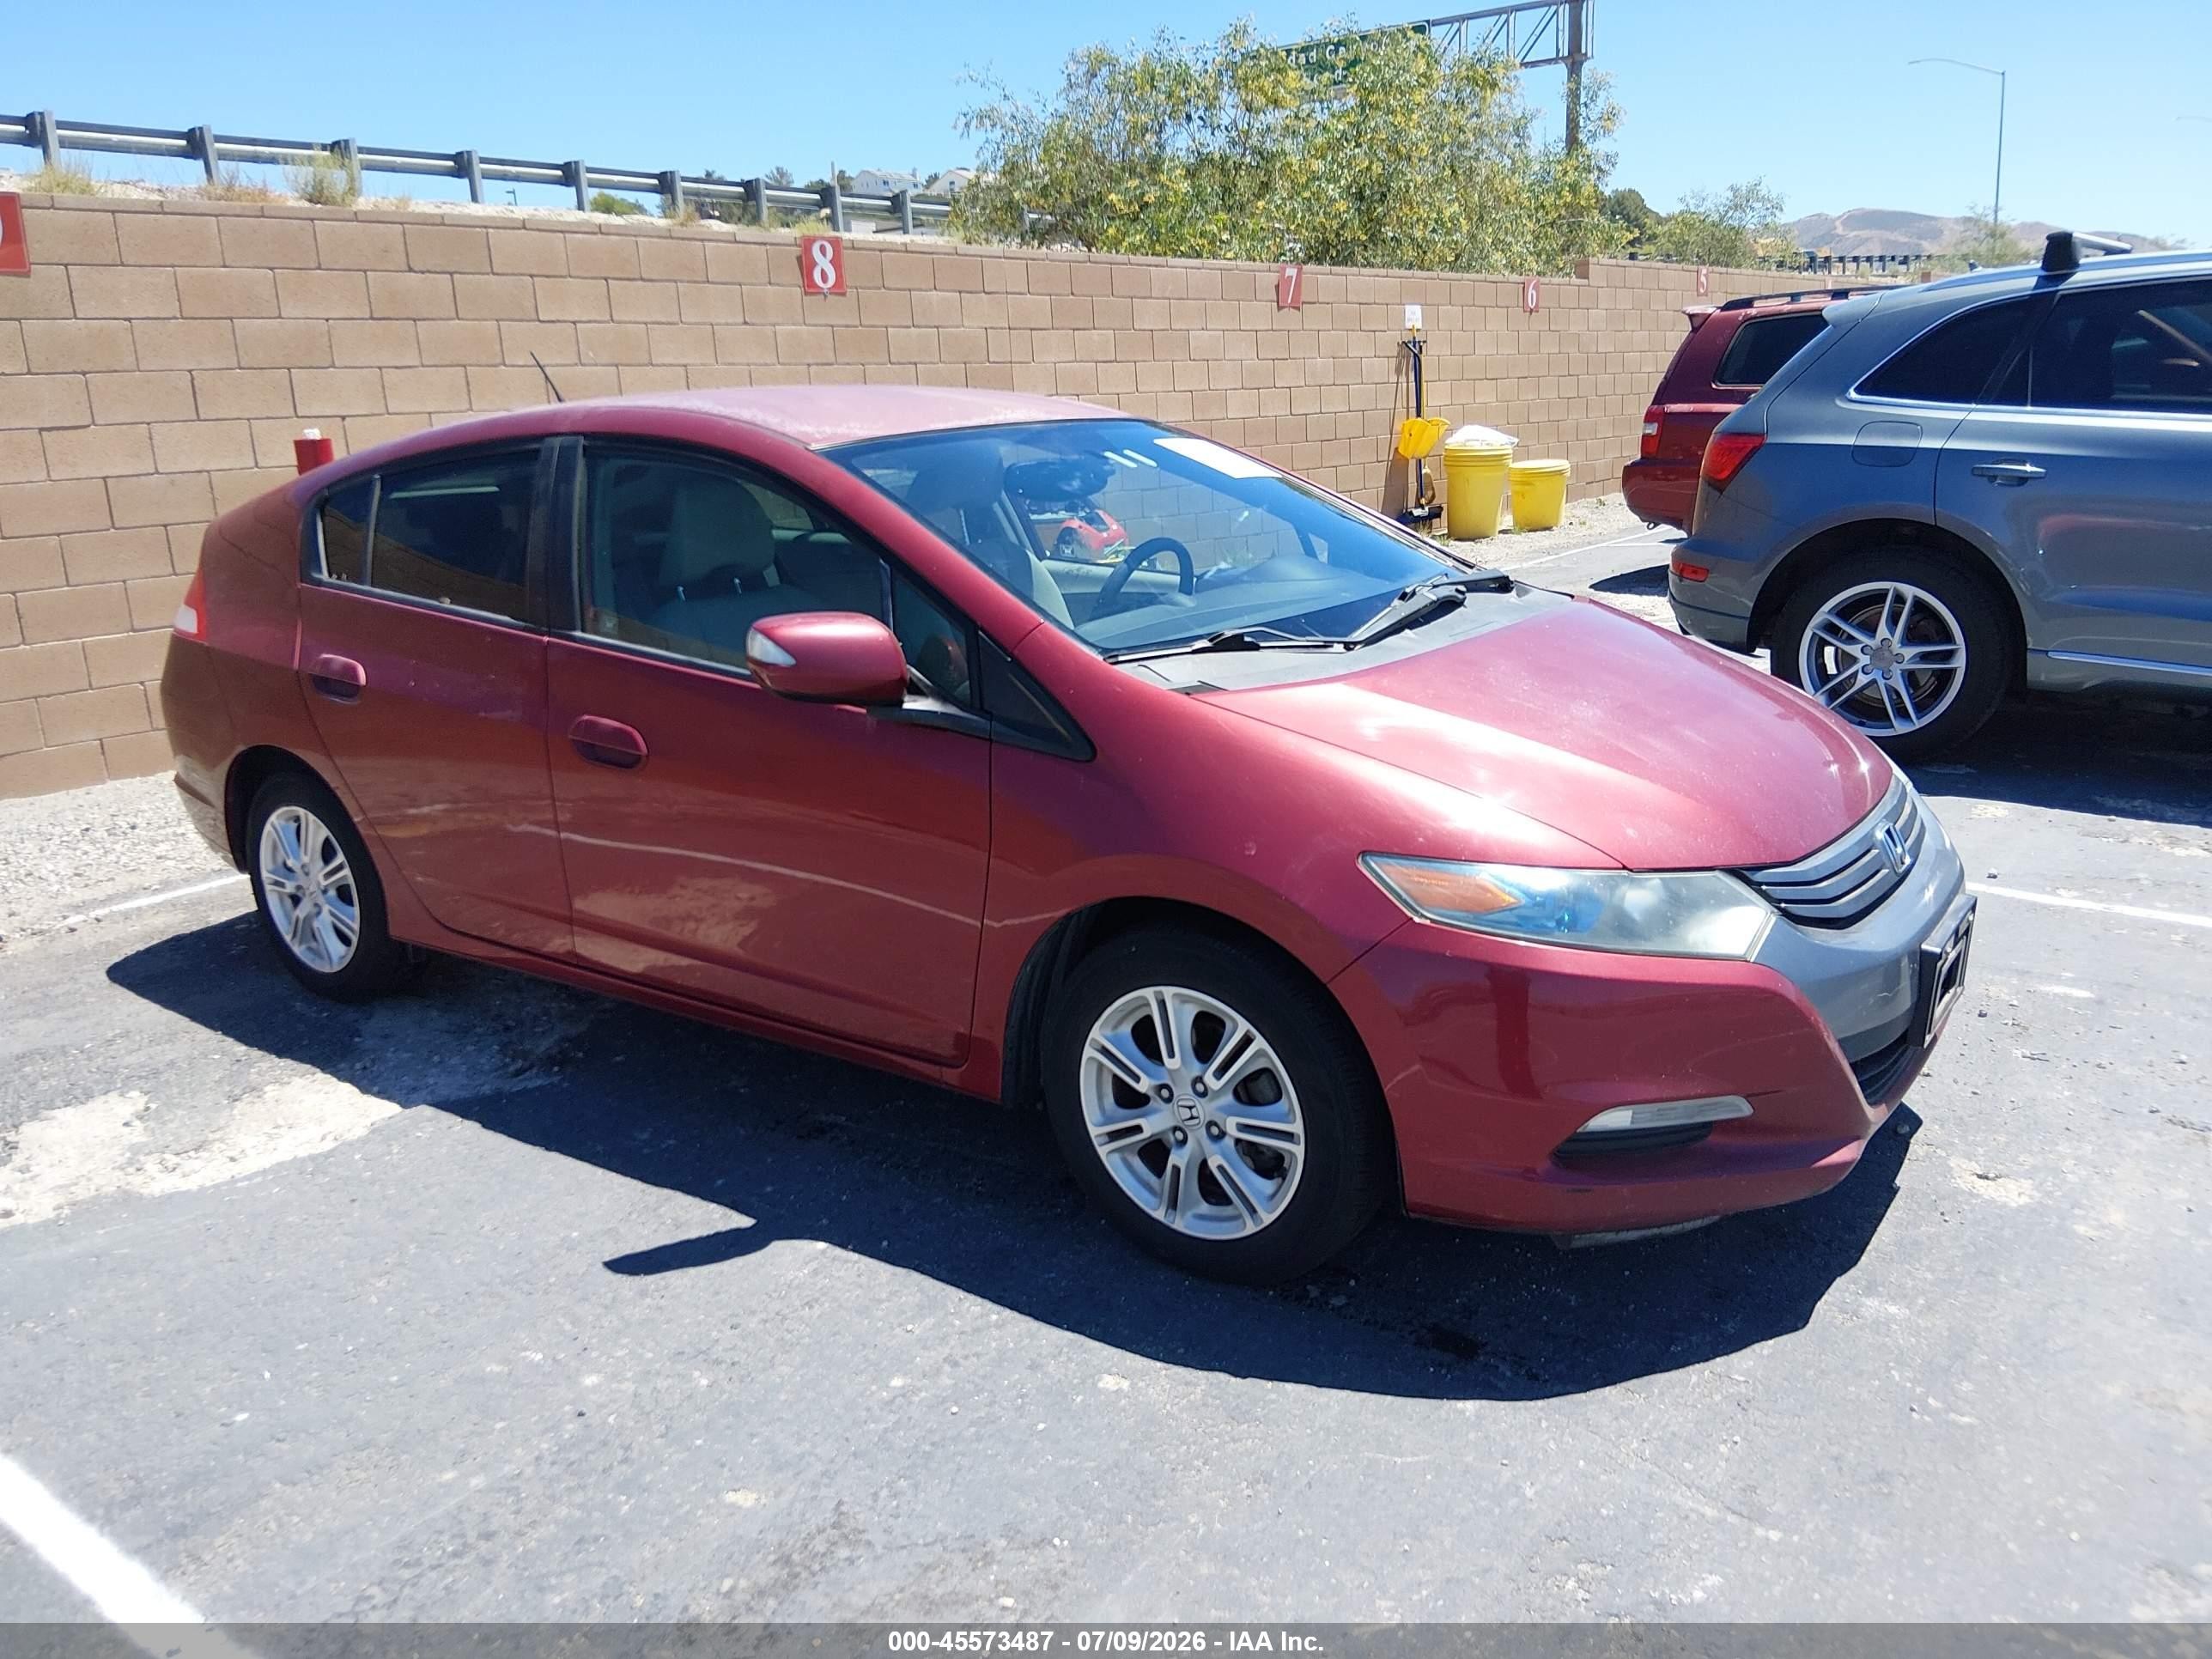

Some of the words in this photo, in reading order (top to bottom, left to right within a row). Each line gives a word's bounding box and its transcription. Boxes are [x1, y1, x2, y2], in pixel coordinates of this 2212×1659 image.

[811, 240, 836, 289] 8
[1285, 267, 1297, 304] 7
[1528, 280, 1537, 308] 6
[1699, 268, 1707, 294] 5
